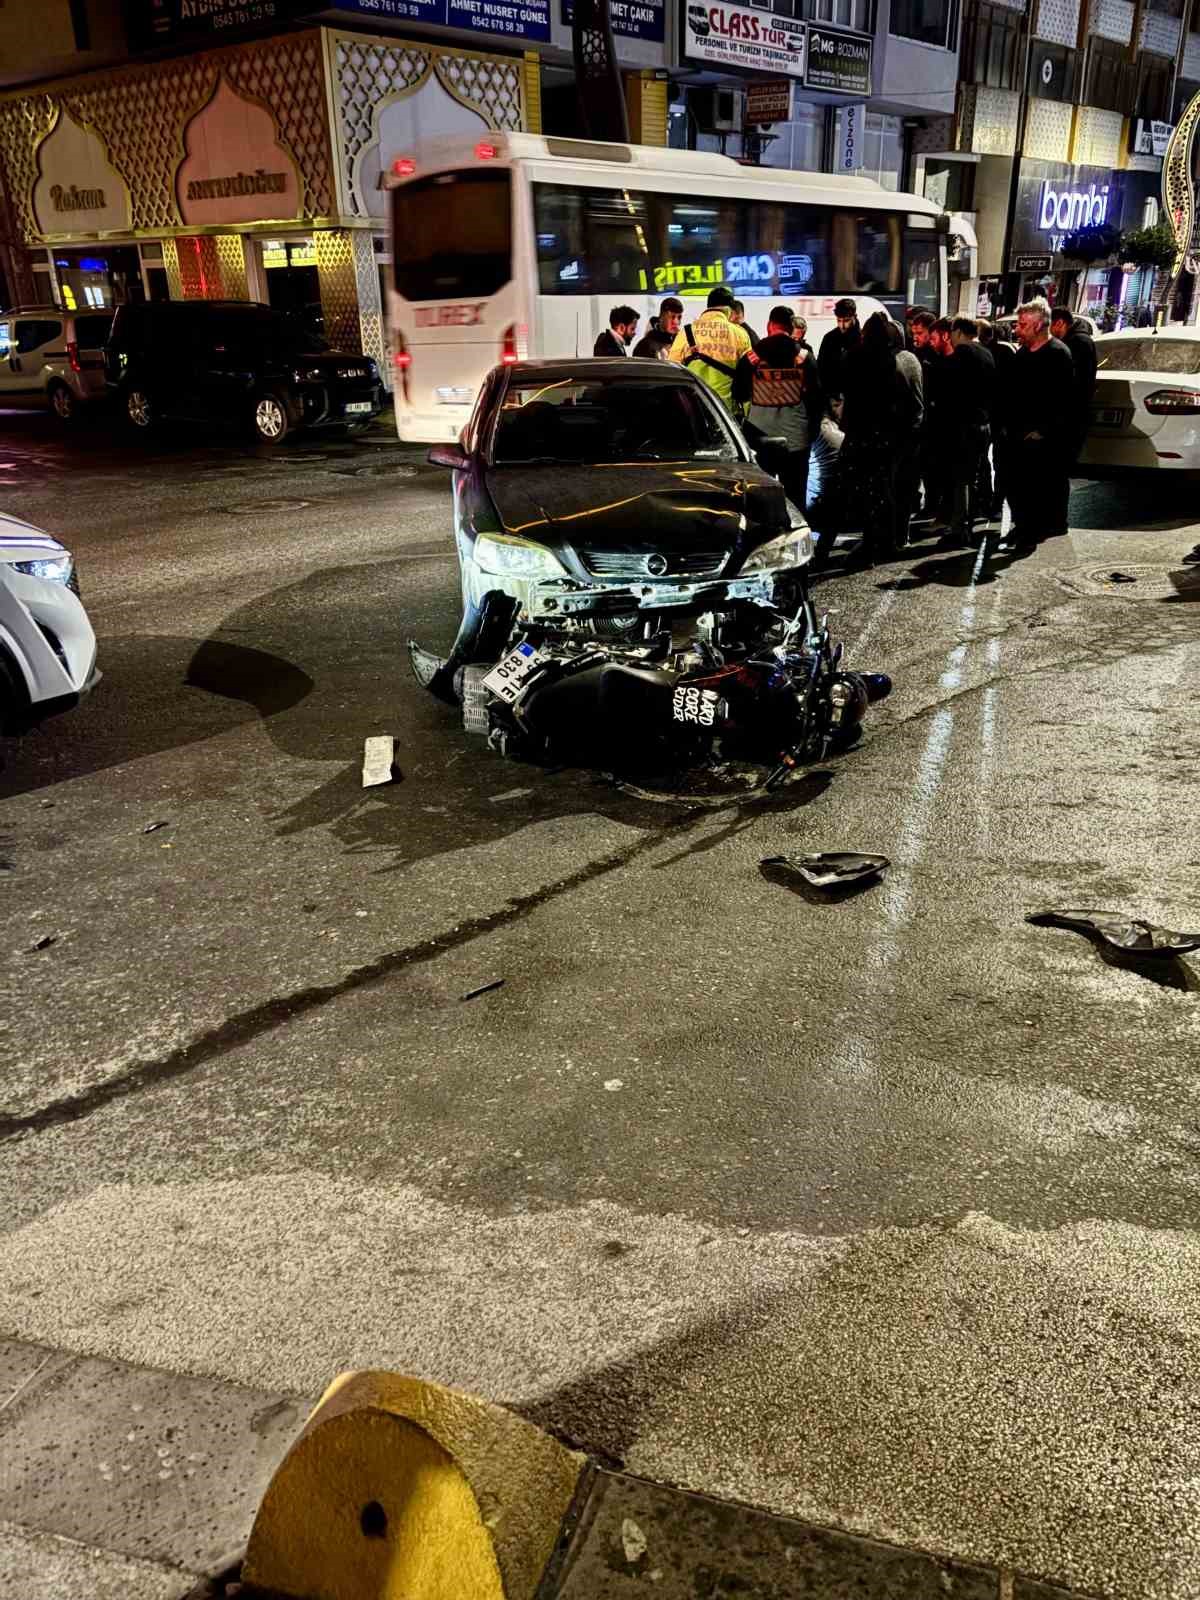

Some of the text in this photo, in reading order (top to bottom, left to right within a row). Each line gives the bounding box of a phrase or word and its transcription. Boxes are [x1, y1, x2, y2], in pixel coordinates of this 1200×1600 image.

[450, 1, 481, 13] AHMET
[484, 4, 517, 19] NUSRET
[520, 8, 548, 25] GÜNEL
[630, 6, 655, 22] ÇAKIR
[709, 8, 760, 40] CLASS
[761, 27, 786, 47] TUR
[696, 36, 727, 50] PERSONEL
[729, 42, 738, 52] VE
[821, 38, 869, 60] MG BOZMAN
[844, 107, 856, 168] eczane
[1039, 179, 1109, 230] bambi
[496, 656, 523, 678] 830
[672, 686, 686, 722] RIDER
[684, 687, 700, 724] CORE
